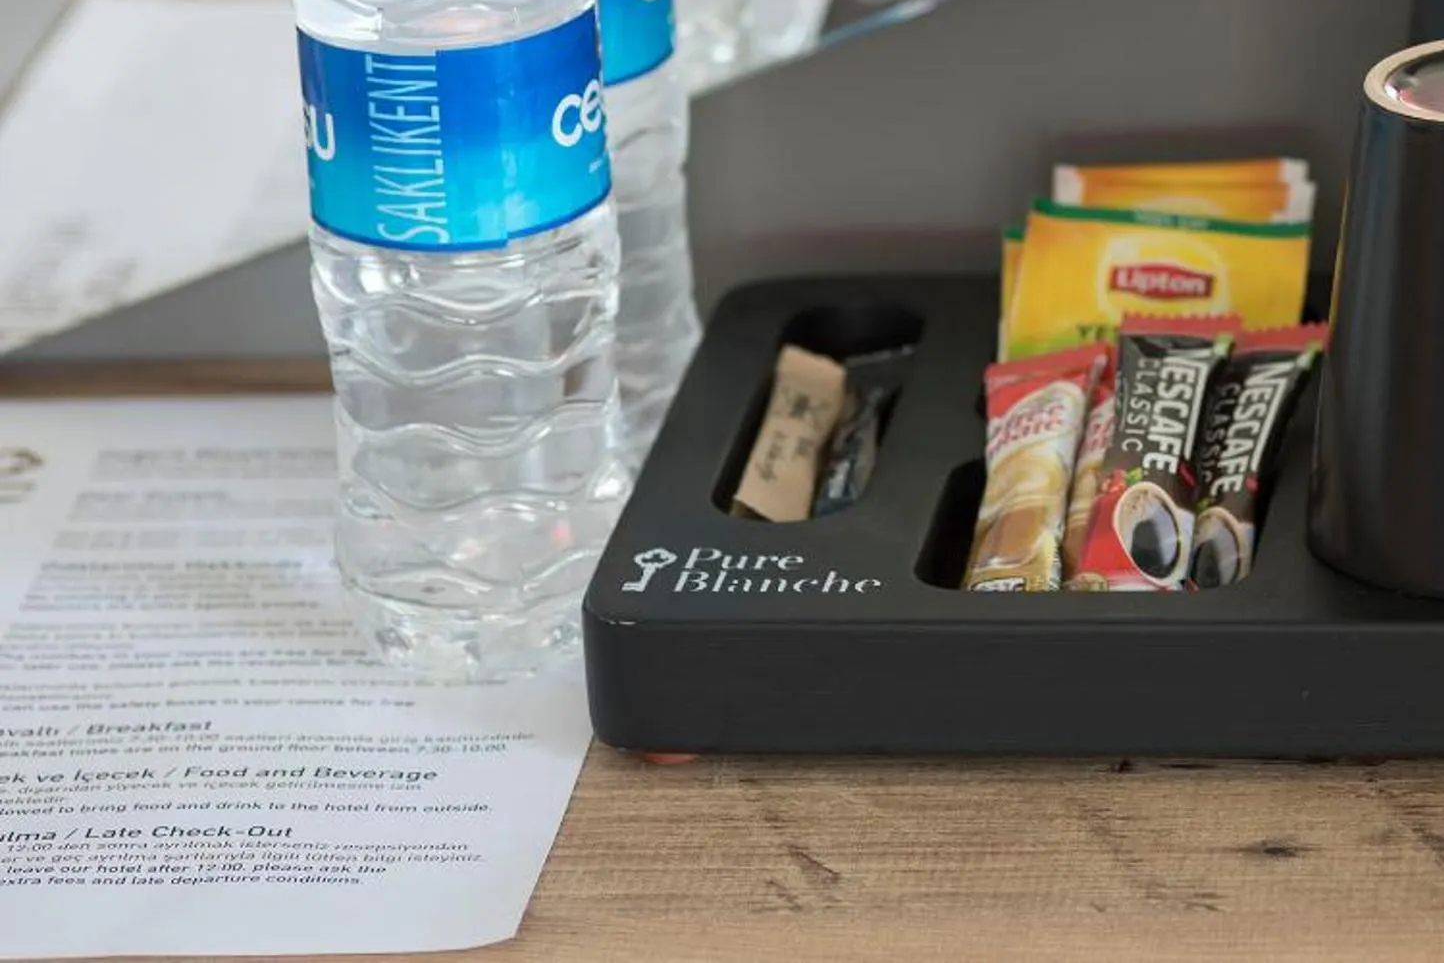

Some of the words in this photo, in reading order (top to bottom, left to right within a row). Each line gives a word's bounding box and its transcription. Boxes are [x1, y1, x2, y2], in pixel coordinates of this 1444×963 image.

[365, 55, 450, 244] SAKLIKENT
[1116, 267, 1206, 295] Lipton
[1121, 357, 1161, 452] CLASSIC
[684, 547, 805, 571] Pure
[673, 570, 883, 593] Blanche
[87, 721, 212, 735] Breakfast
[37, 775, 64, 783] ve
[184, 766, 248, 778] Food
[256, 767, 305, 778] and
[315, 767, 437, 782] Beverage
[80, 803, 127, 812] bring
[134, 802, 172, 810] food
[177, 801, 211, 810] and
[216, 801, 262, 810] drink
[291, 802, 319, 811] the
[325, 803, 369, 812] hotel
[375, 804, 417, 812] from
[85, 827, 142, 839] Late
[152, 825, 293, 839] Check-Out
[96, 864, 142, 873] hotel
[148, 863, 189, 873] after
[251, 862, 313, 873] please
[319, 864, 352, 873] ask
[92, 875, 131, 885] and
[131, 875, 165, 885] late
[171, 874, 260, 886] departure
